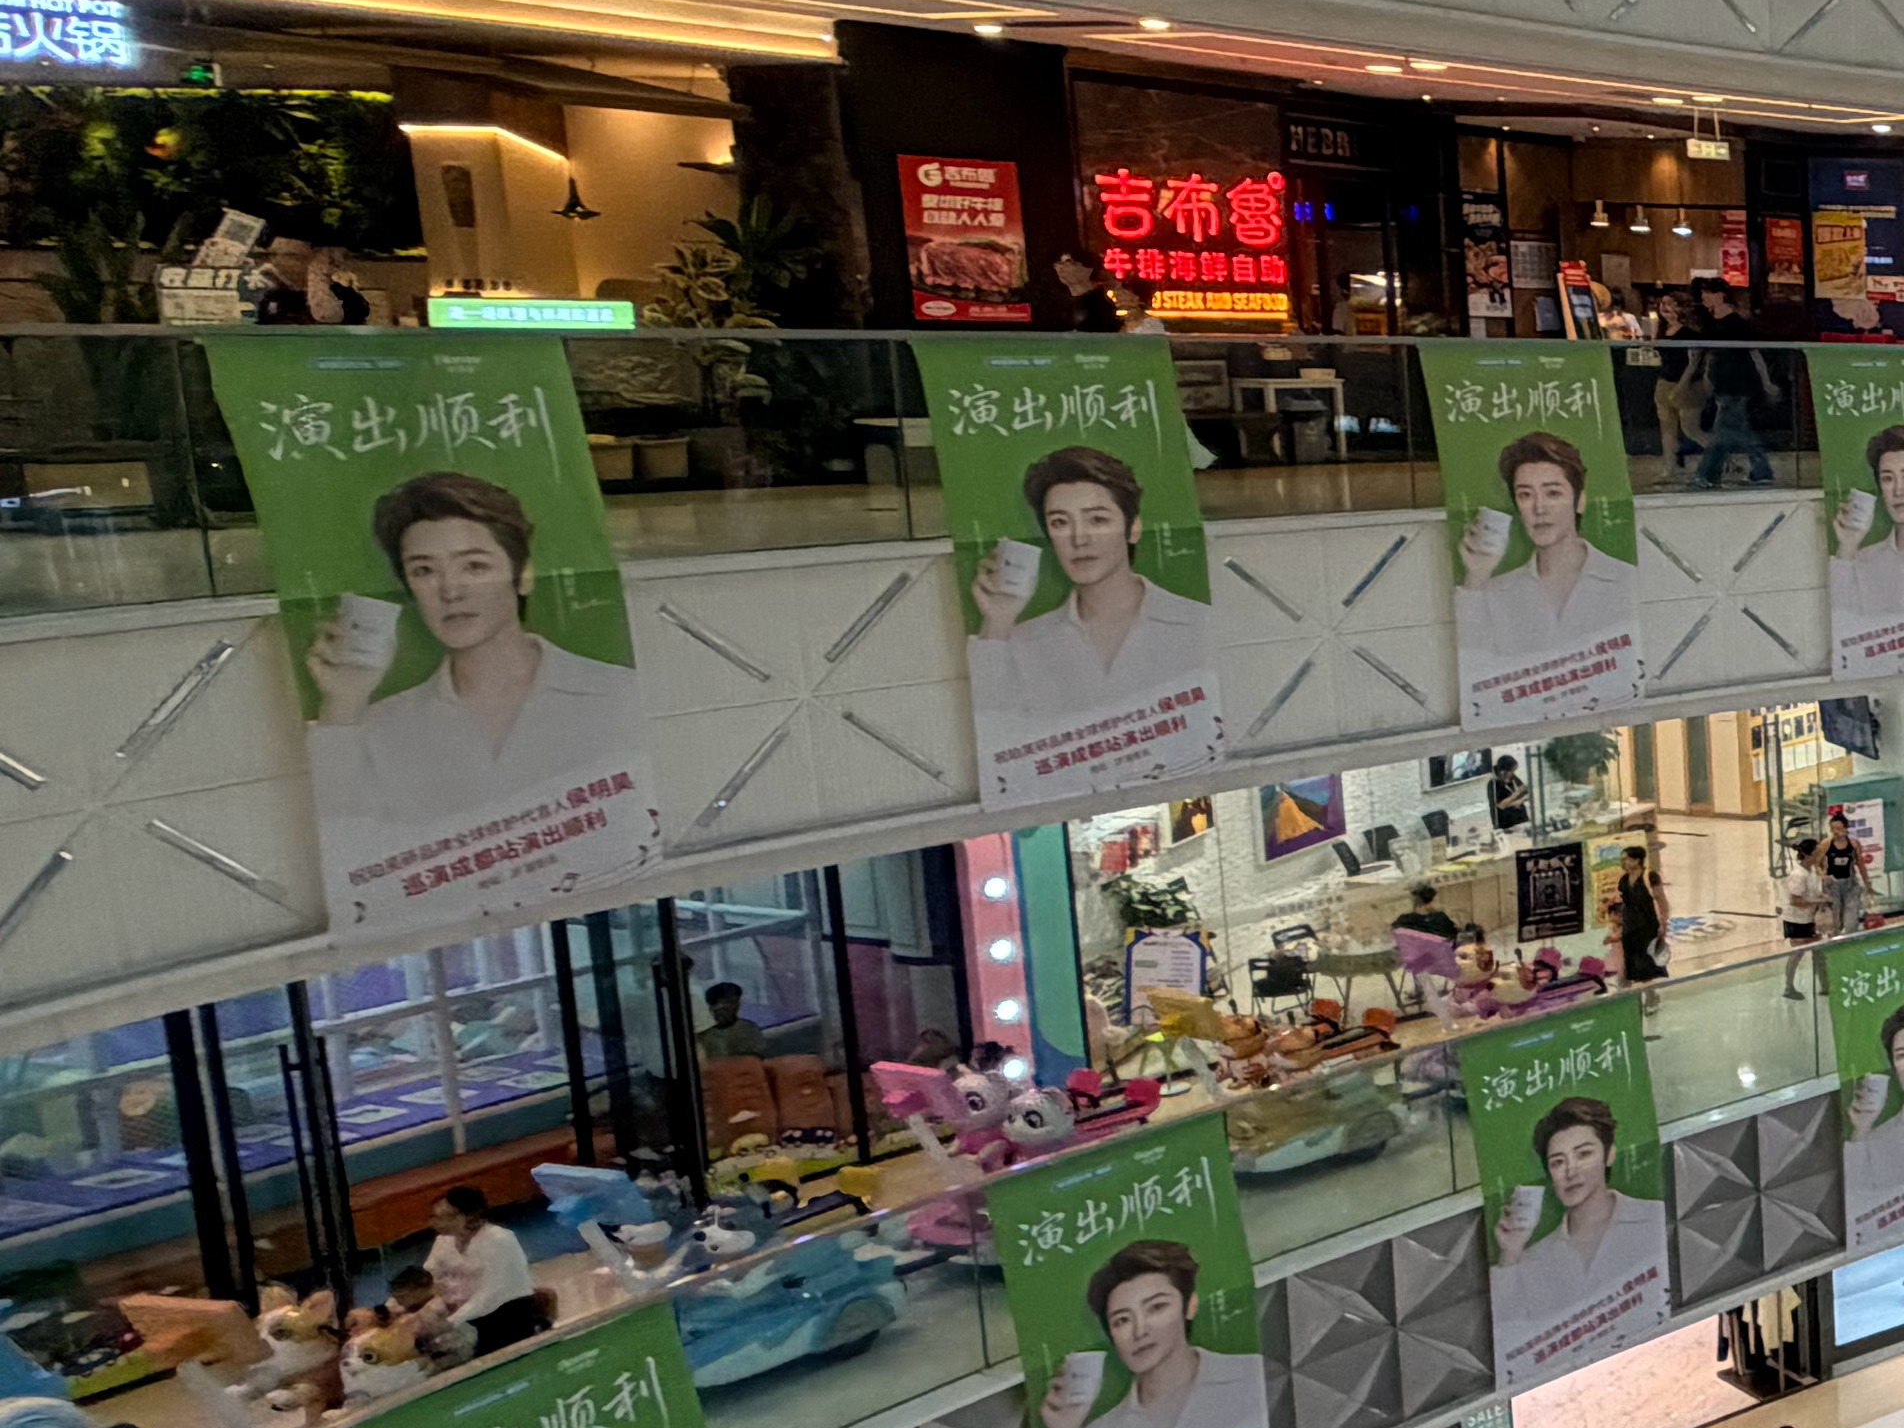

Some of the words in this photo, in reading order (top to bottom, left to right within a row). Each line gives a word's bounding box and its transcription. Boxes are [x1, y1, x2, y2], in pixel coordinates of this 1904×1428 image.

[1103, 247, 1288, 285] 牛排海鲜自助
[1160, 290, 1203, 310] STEAK
[1230, 292, 1288, 312] SEAFOOD
[258, 385, 559, 484] 演出顺利
[949, 379, 1160, 456] 演出顺利
[1443, 378, 1602, 432] 演出顺利
[1481, 1031, 1632, 1111] 演出顺利
[1019, 1156, 1217, 1266] 演出顺利
